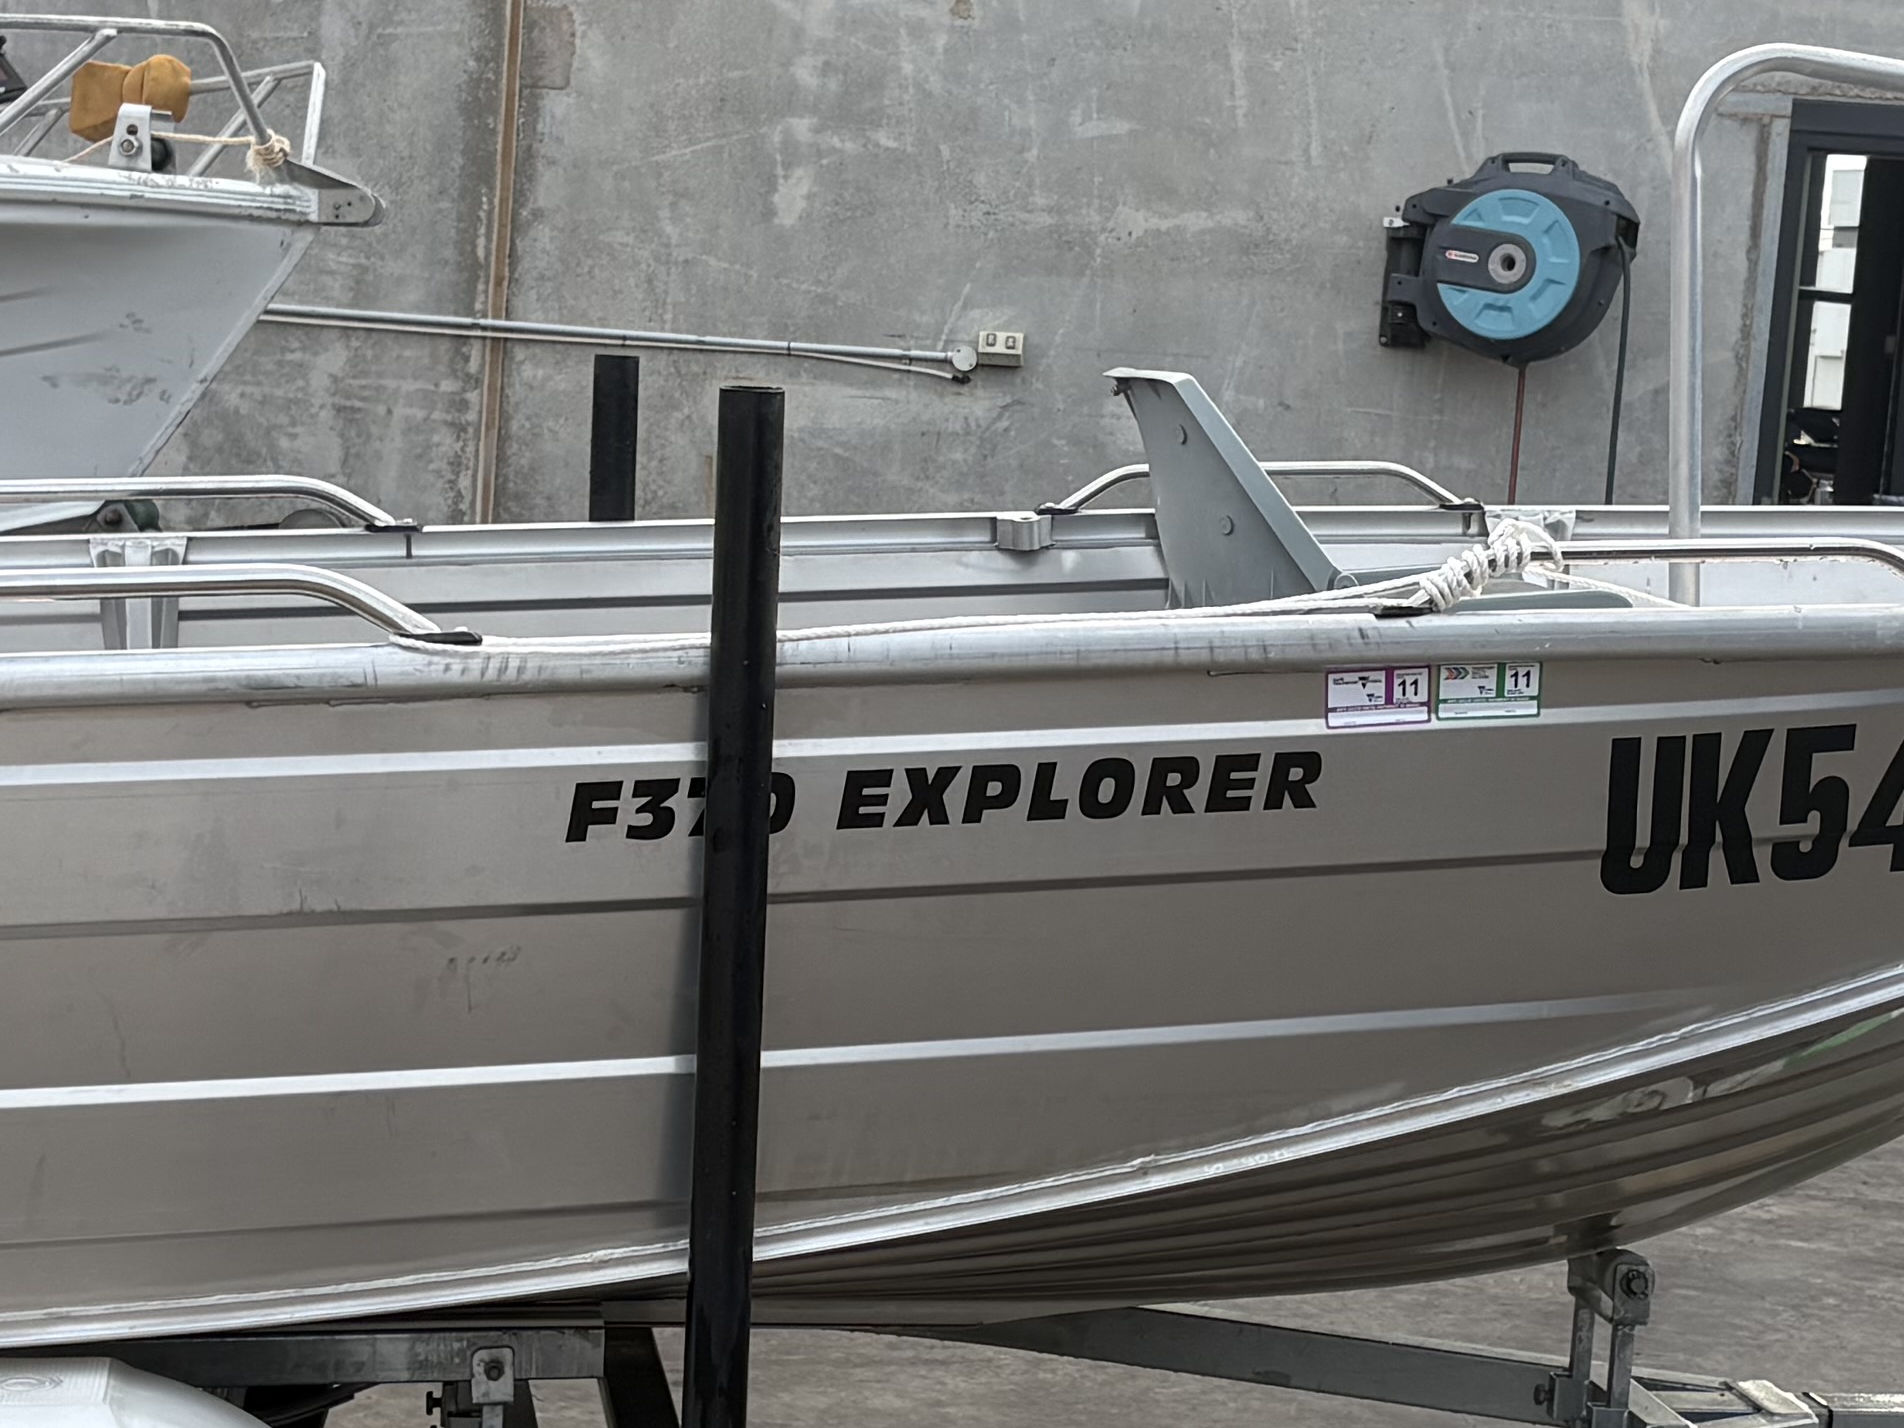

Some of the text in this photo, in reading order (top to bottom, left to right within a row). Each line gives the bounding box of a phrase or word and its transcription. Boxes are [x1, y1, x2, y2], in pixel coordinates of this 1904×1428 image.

[1398, 677, 1419, 697] 11
[1510, 669, 1531, 689] 11
[836, 751, 1322, 830] EXPLORER
